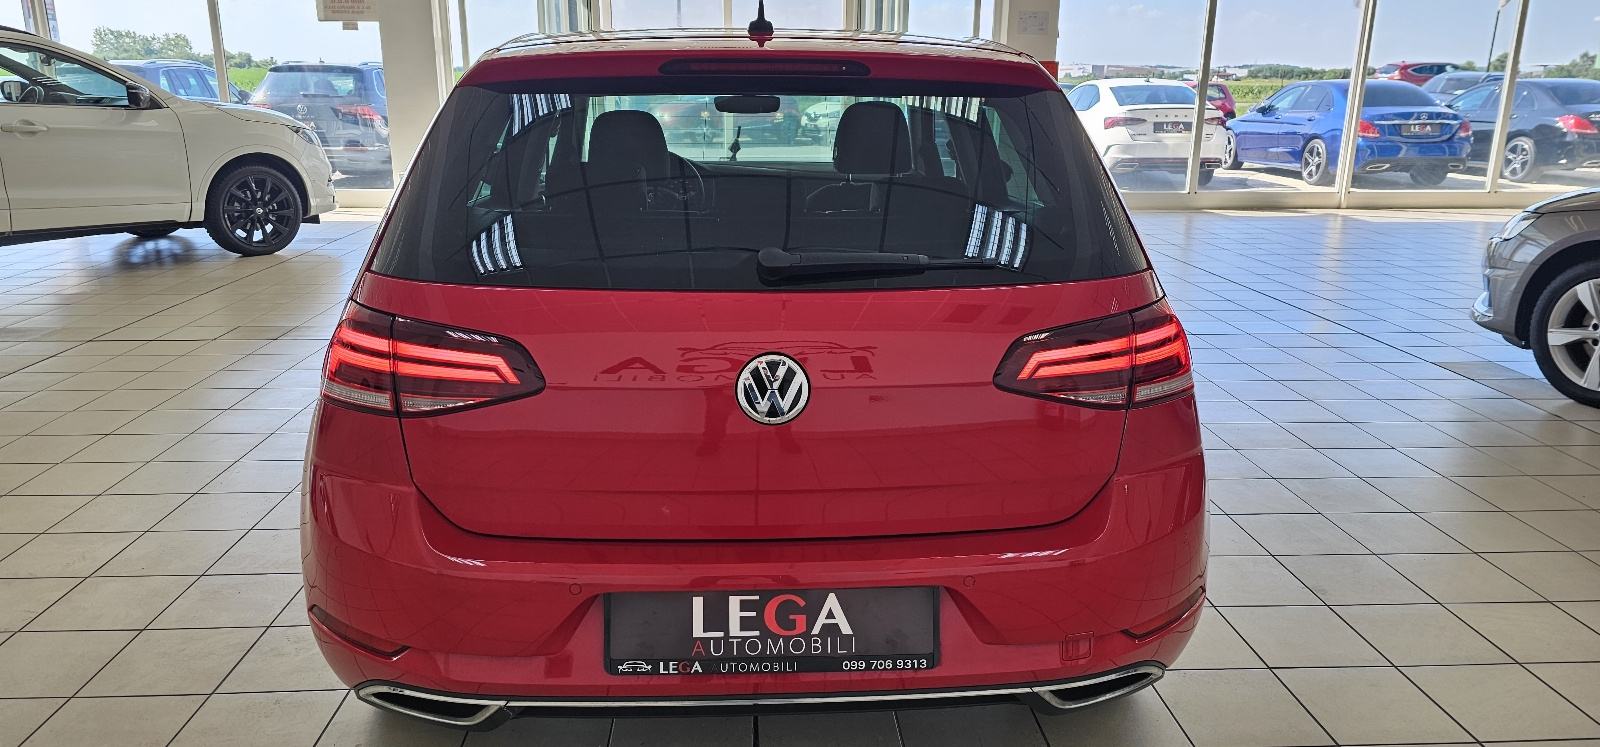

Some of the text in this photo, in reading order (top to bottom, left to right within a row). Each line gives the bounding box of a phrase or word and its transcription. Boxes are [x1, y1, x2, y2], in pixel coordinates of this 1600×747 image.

[692, 592, 854, 638] LEGA
[691, 636, 856, 657] AUTOMOBILI
[659, 660, 798, 674] LEGA AUTOMOBILI
[842, 658, 927, 670] 099 706 9313
